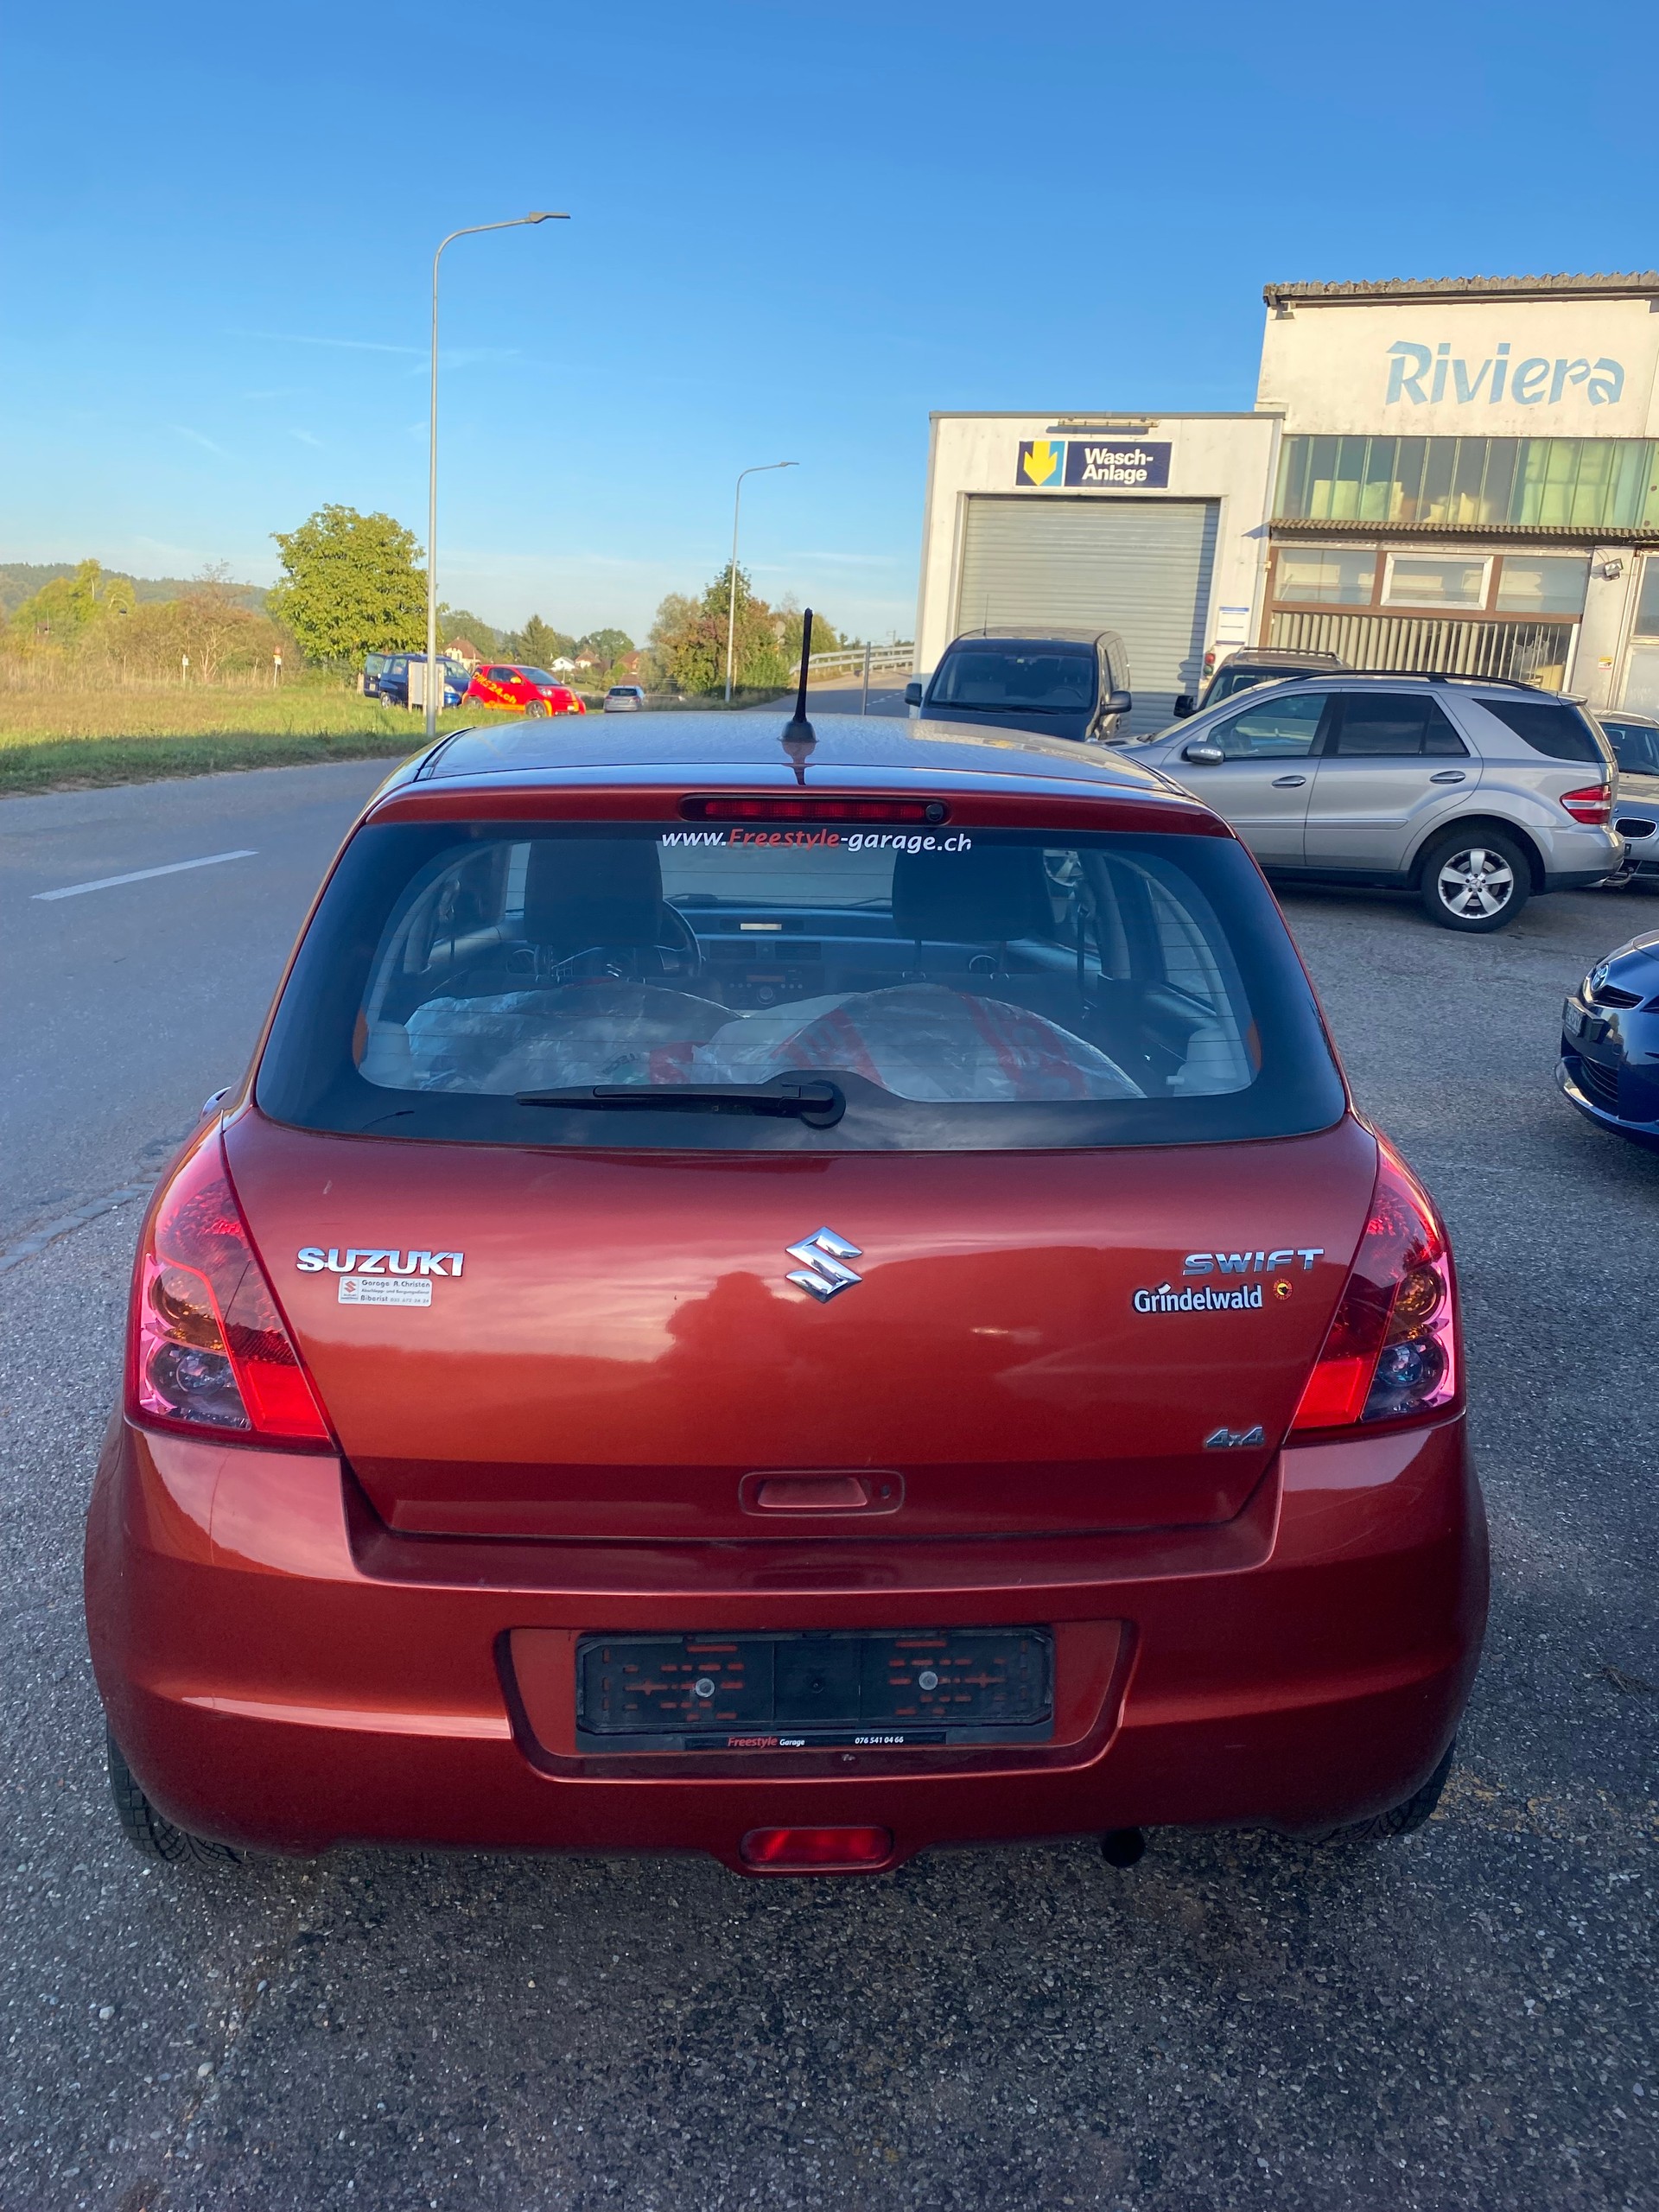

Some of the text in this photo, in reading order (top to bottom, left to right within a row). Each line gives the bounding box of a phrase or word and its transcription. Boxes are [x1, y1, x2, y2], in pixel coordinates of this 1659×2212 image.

[1385, 340, 1625, 405] Riviera
[1084, 448, 1154, 466] Wasch-
[1082, 464, 1147, 485] Anlage
[662, 828, 972, 854] www.Freestyle-garage.ch
[296, 1247, 464, 1277] SUZUKI
[1182, 1248, 1325, 1276] SWIFT
[1134, 1283, 1263, 1313] Grindelwald
[1205, 1426, 1264, 1448] 4x4
[728, 1736, 778, 1749] Freestyle
[779, 1738, 805, 1747] Garage
